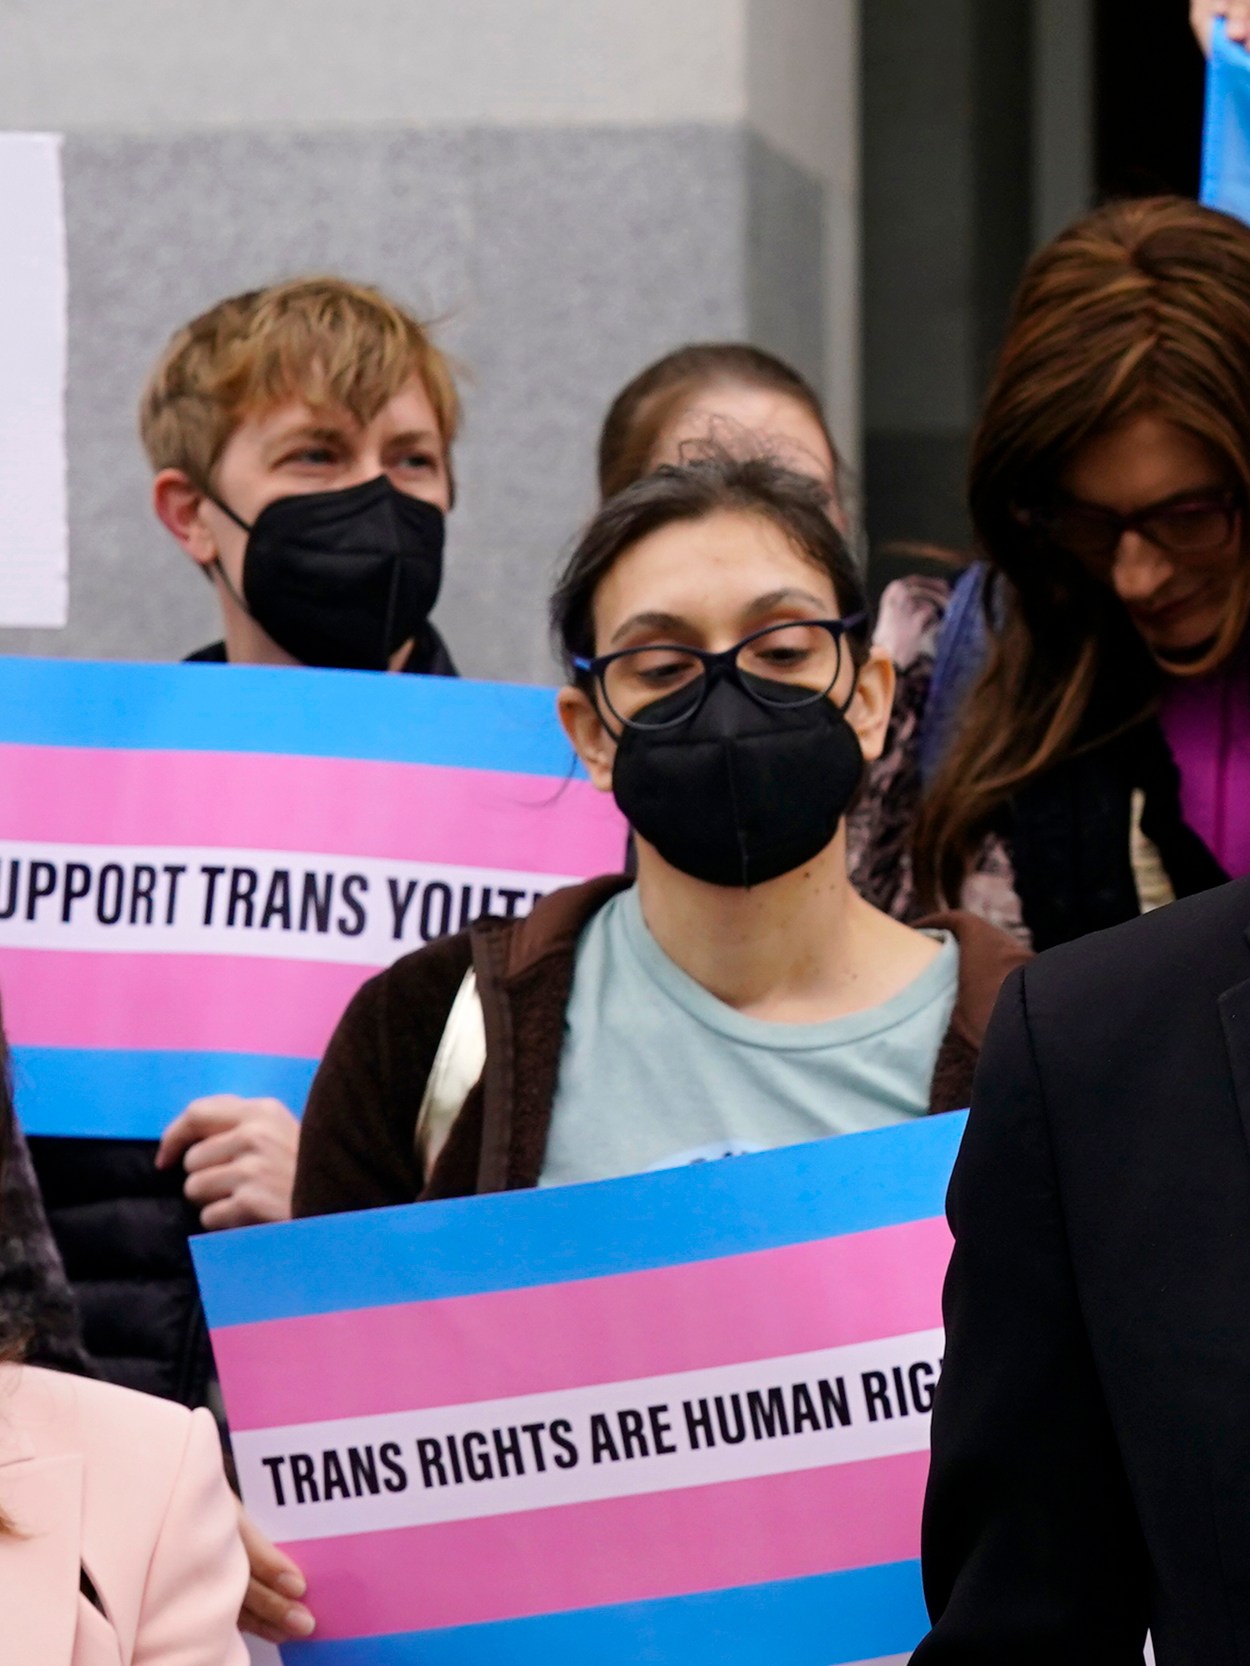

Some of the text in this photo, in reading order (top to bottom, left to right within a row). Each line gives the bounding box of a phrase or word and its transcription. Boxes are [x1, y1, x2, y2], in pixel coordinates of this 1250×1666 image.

[200, 865, 369, 937] TRANS
[387, 878, 542, 941] YOUT
[261, 1357, 943, 1507] TRANS RIGHTS ARE HUMAN RIG
